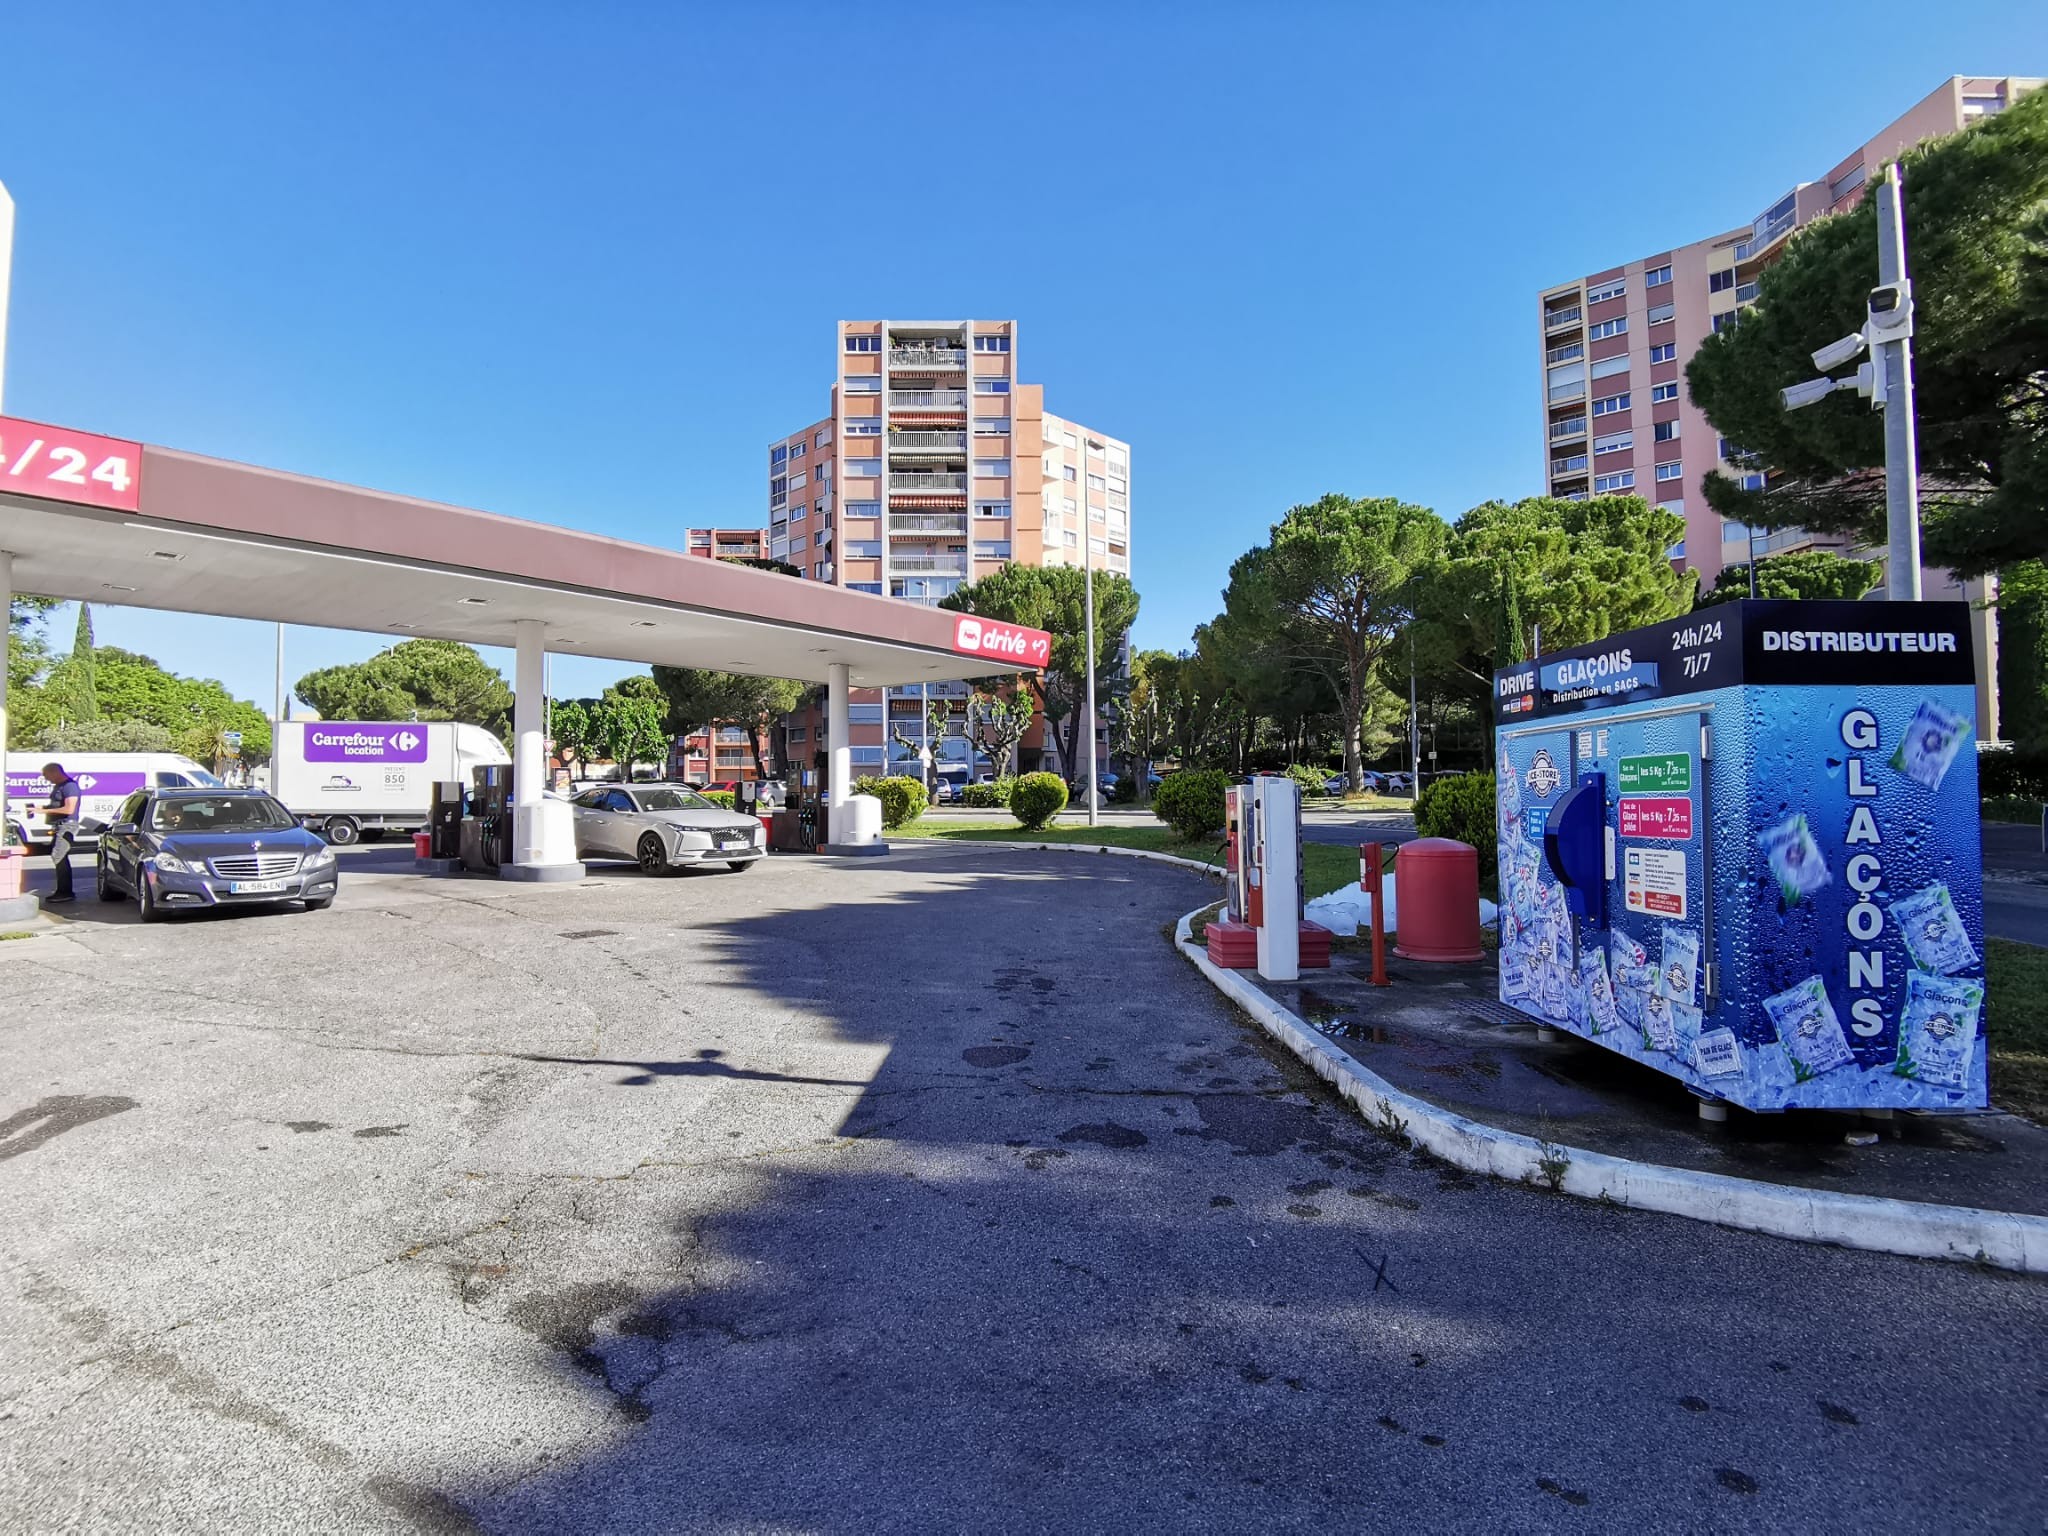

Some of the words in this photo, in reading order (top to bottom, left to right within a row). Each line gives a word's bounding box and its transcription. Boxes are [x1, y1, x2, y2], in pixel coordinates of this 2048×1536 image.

[0, 435, 131, 492] /24
[983, 628, 1026, 655] drive
[1672, 621, 1722, 650] 24h/24
[1763, 631, 1956, 652] DISTRIBUTEUR
[1557, 649, 1632, 685] GLAÇONS
[1683, 652, 1711, 679] 7j/7
[1500, 671, 1534, 697] DRIVE
[1553, 687, 1599, 703] Distribution
[1601, 685, 1612, 694] en
[1614, 677, 1639, 692] SACS
[312, 732, 384, 746] Carrefour
[345, 746, 384, 755] location
[385, 774, 405, 784] 850
[1654, 766, 1662, 777] Kg
[94, 804, 113, 812] 850
[1655, 812, 1663, 823] Kg
[1842, 711, 1884, 1037] GLAÇONS
[1783, 995, 1817, 1014] Glaçons
[1924, 989, 1968, 1006] Glaçons
